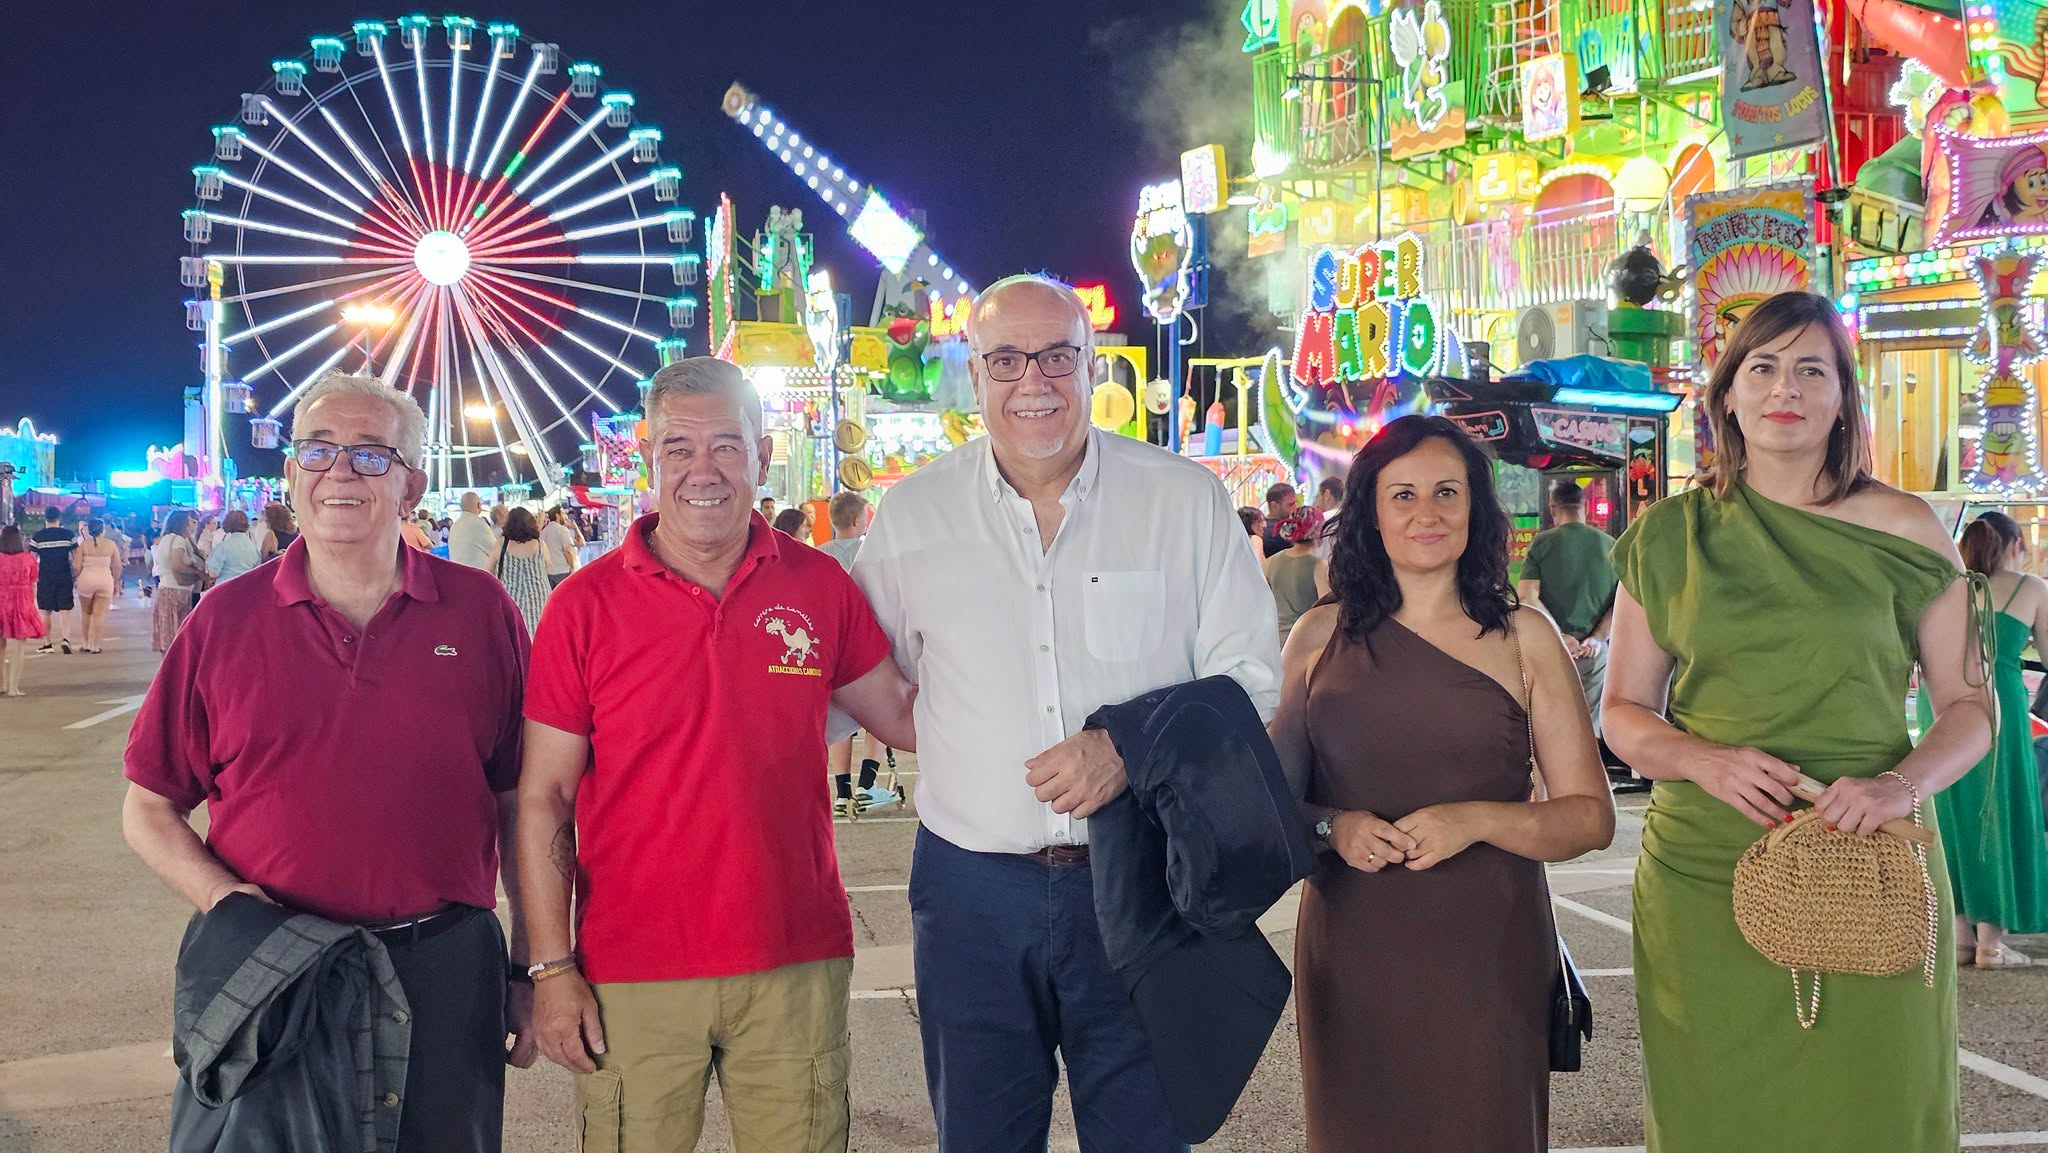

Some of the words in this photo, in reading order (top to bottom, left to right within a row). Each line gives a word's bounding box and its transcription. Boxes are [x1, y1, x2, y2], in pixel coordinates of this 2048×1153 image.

[1784, 84, 1820, 117] LOCOS
[1311, 234, 1424, 310] SUPER
[1294, 298, 1440, 387] MARIO
[1554, 418, 1618, 443] CASINO
